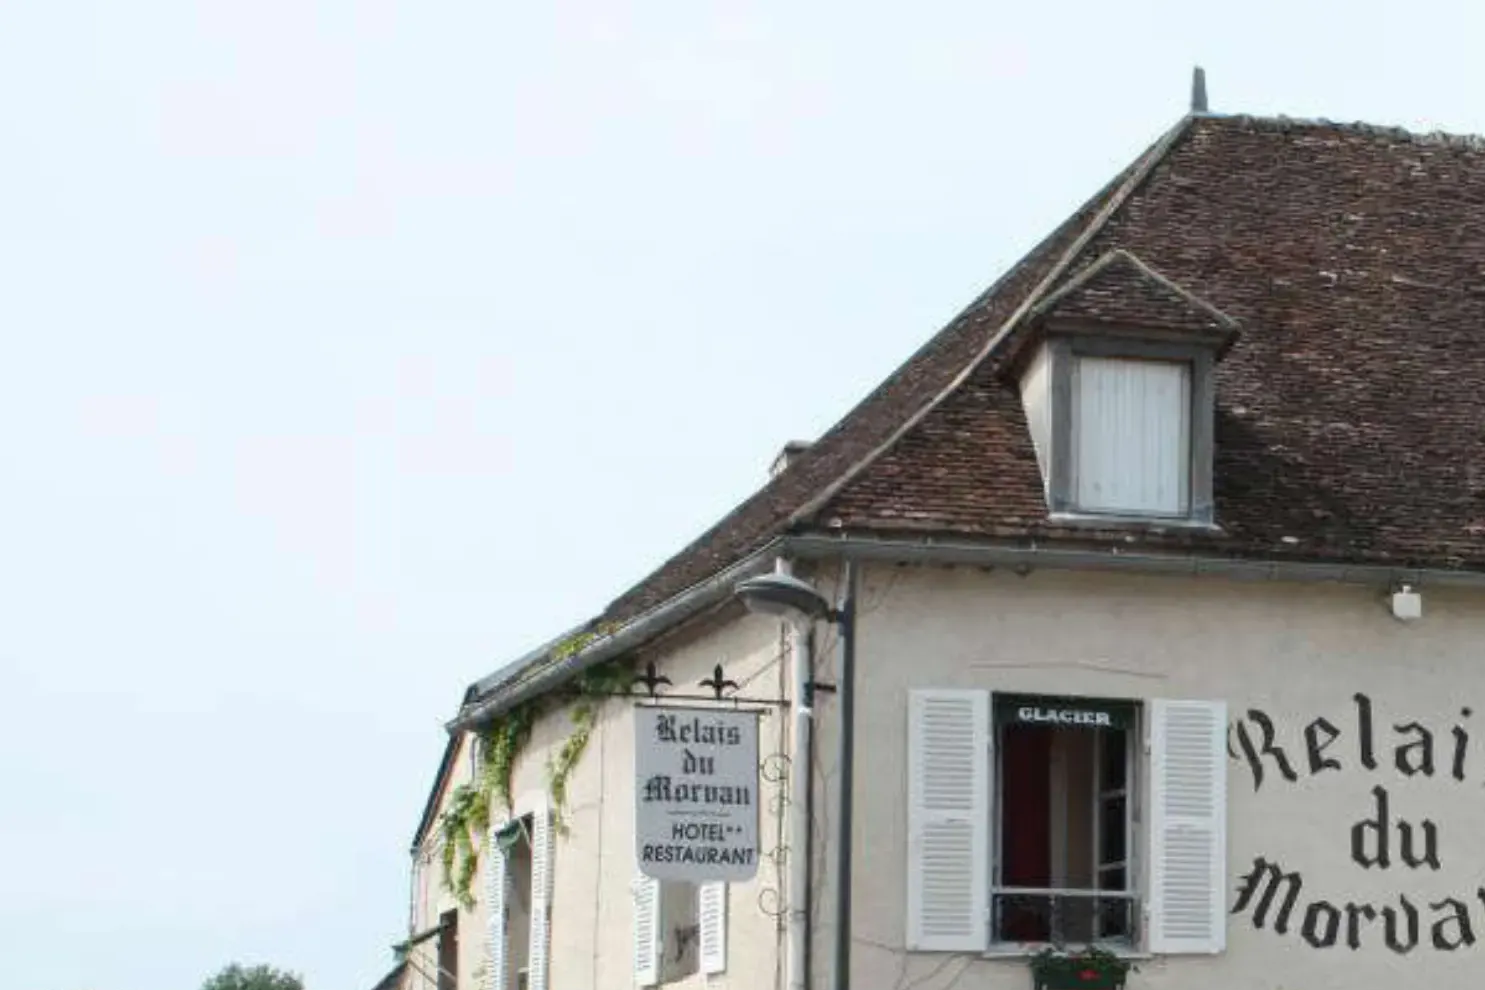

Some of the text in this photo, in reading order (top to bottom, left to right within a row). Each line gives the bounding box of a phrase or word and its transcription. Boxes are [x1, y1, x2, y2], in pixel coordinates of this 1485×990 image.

[655, 714, 741, 746] Relais
[1018, 707, 1112, 726] GLACIER
[682, 748, 714, 775] du
[642, 775, 752, 806] Morvan
[1351, 785, 1442, 871] du
[642, 844, 754, 866] RESTAURANT
